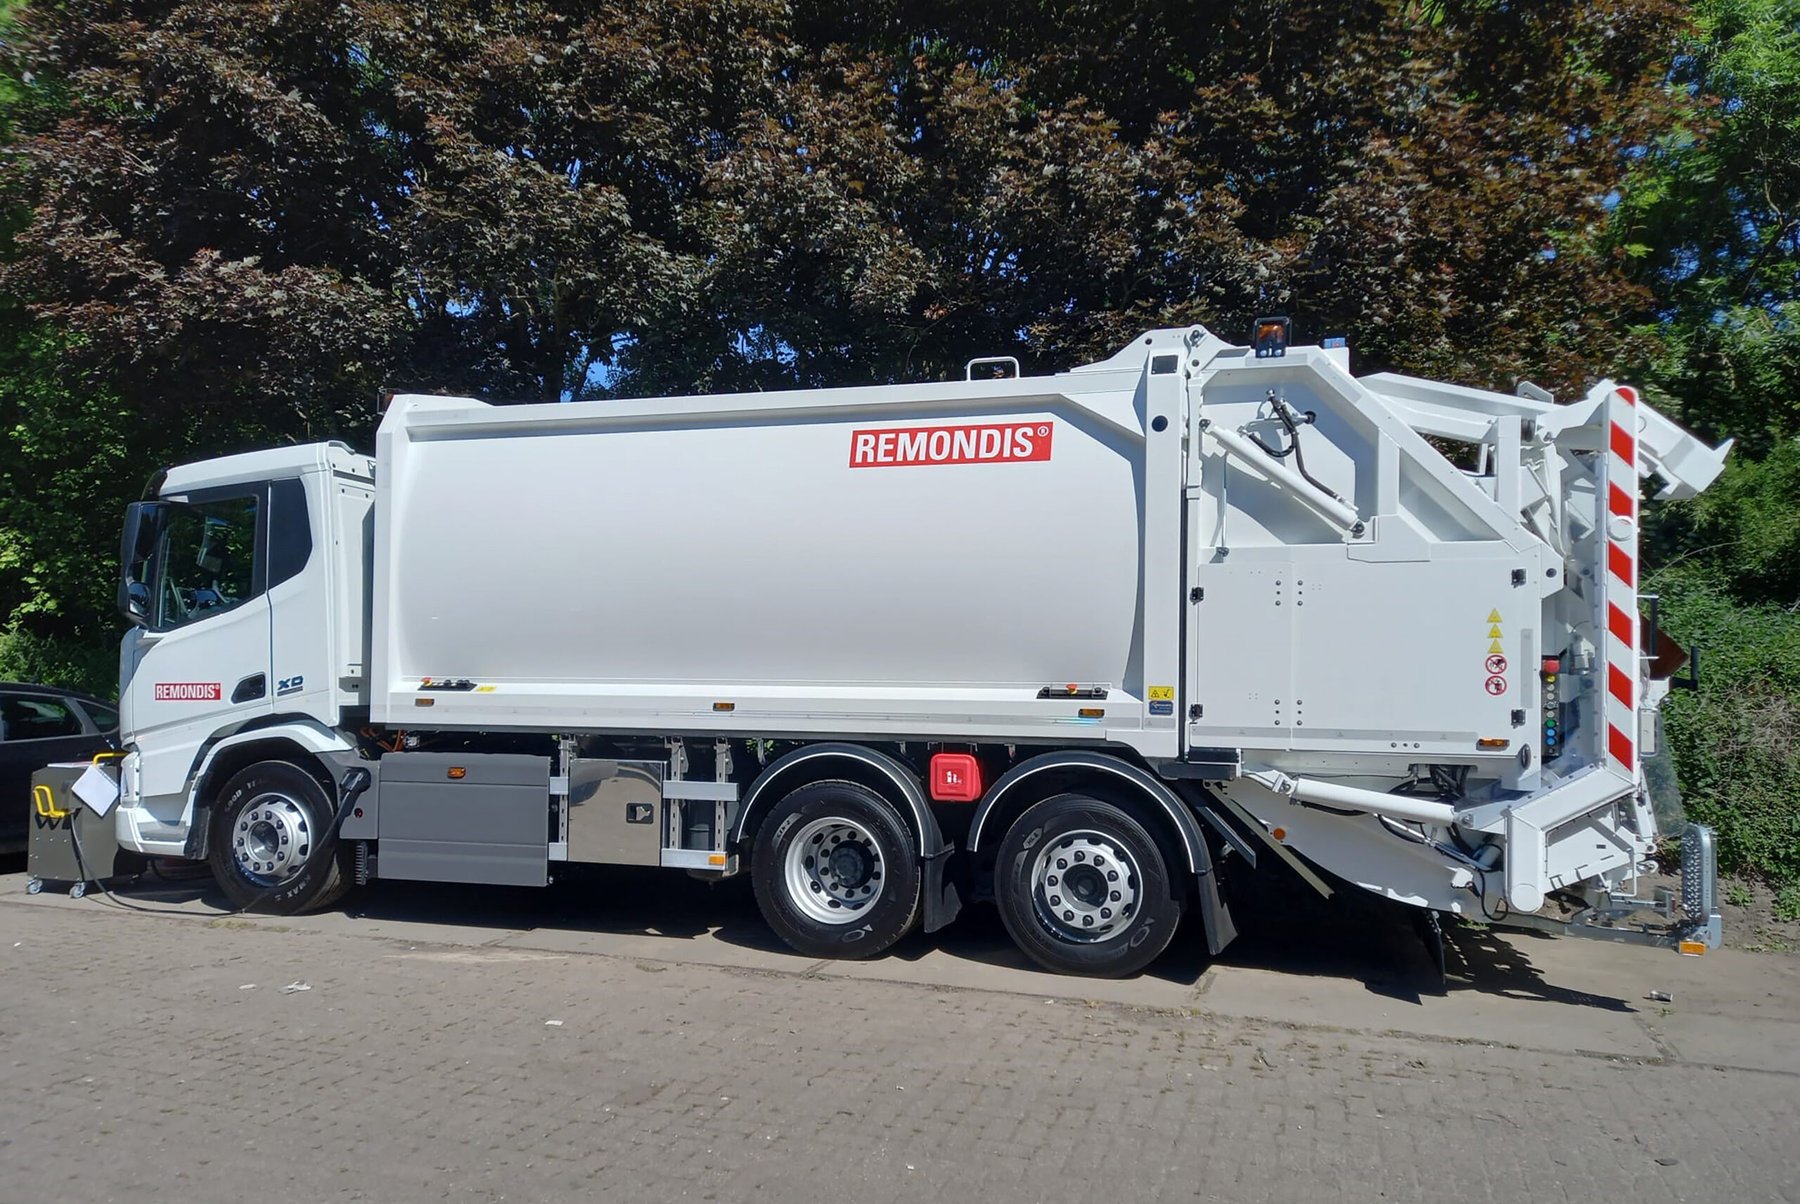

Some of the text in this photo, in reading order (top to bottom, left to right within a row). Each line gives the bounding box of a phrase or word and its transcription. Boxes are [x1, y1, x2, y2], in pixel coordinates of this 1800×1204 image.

[855, 427, 1033, 463] REMONDIS
[277, 675, 304, 690] XD
[156, 684, 215, 699] REMONDIS
